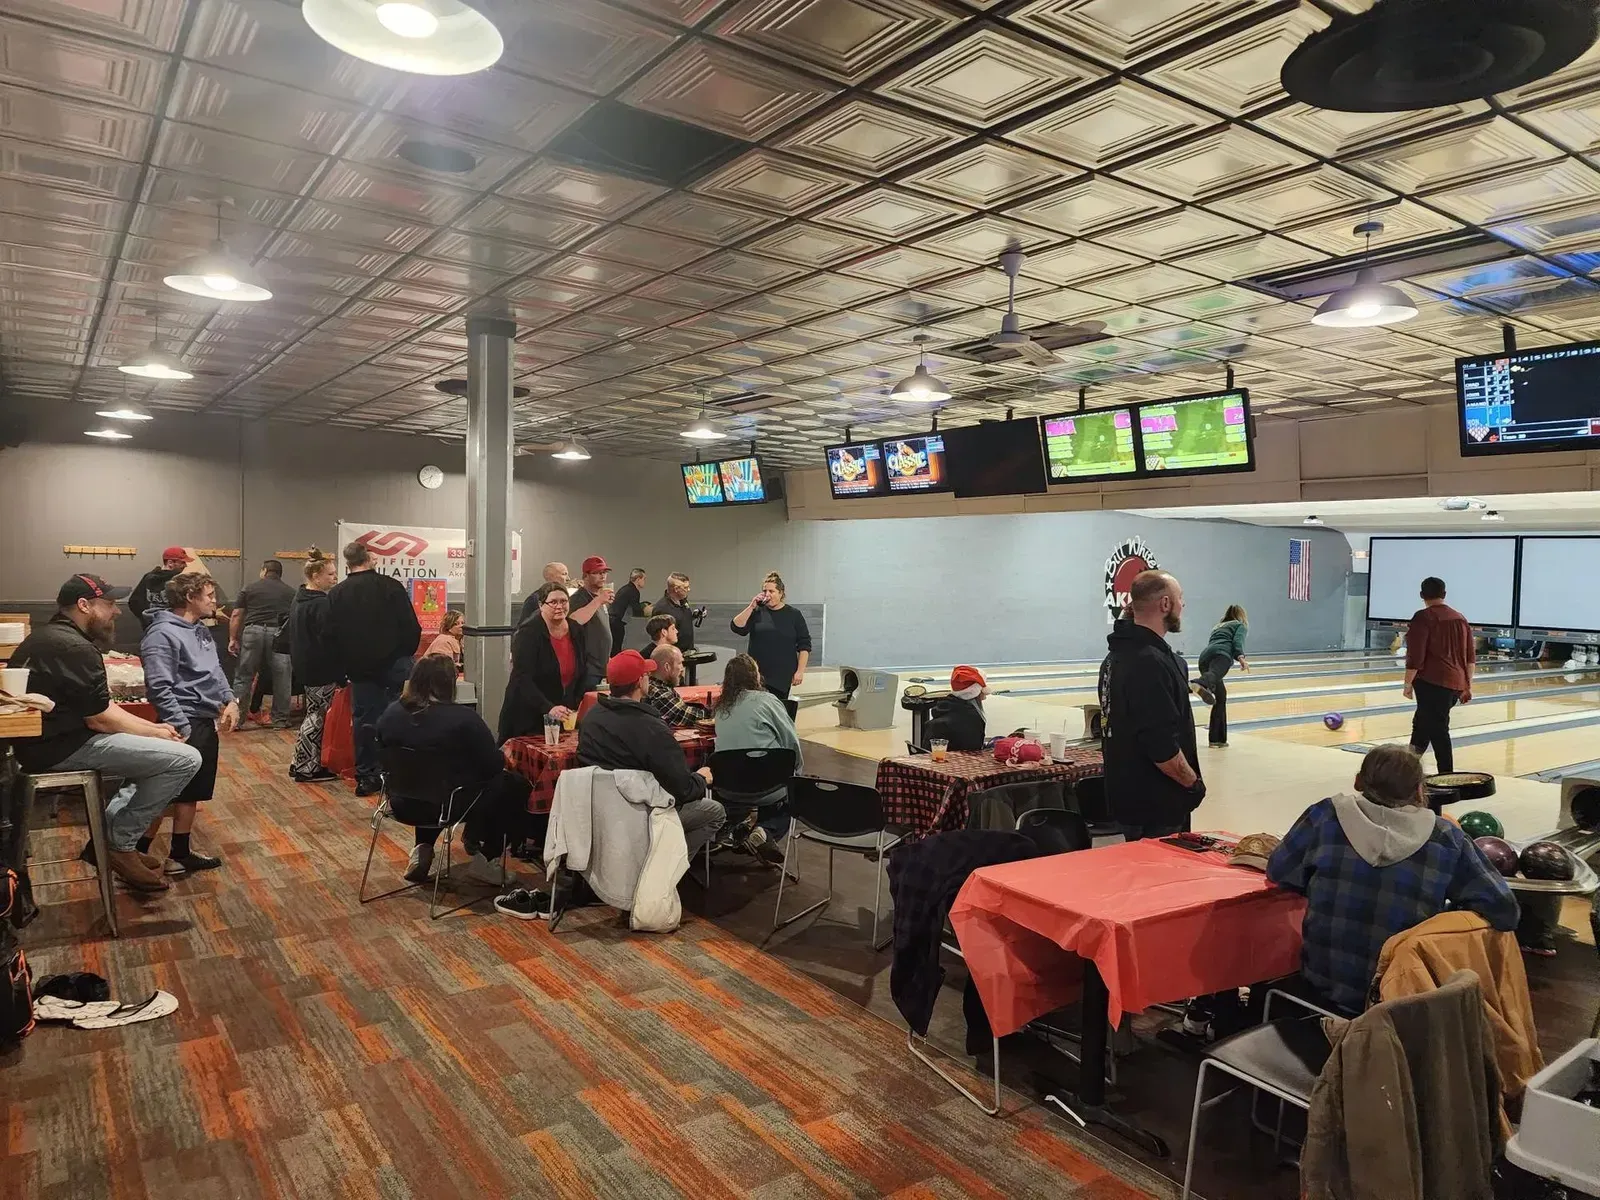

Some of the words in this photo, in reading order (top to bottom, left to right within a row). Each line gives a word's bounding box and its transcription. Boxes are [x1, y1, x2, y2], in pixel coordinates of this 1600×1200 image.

[888, 451, 928, 472] CLASSIC
[382, 557, 426, 566] IFIED
[1104, 541, 1127, 579] Bill
[1497, 629, 1511, 638] 34
[1584, 633, 1598, 643] 35
